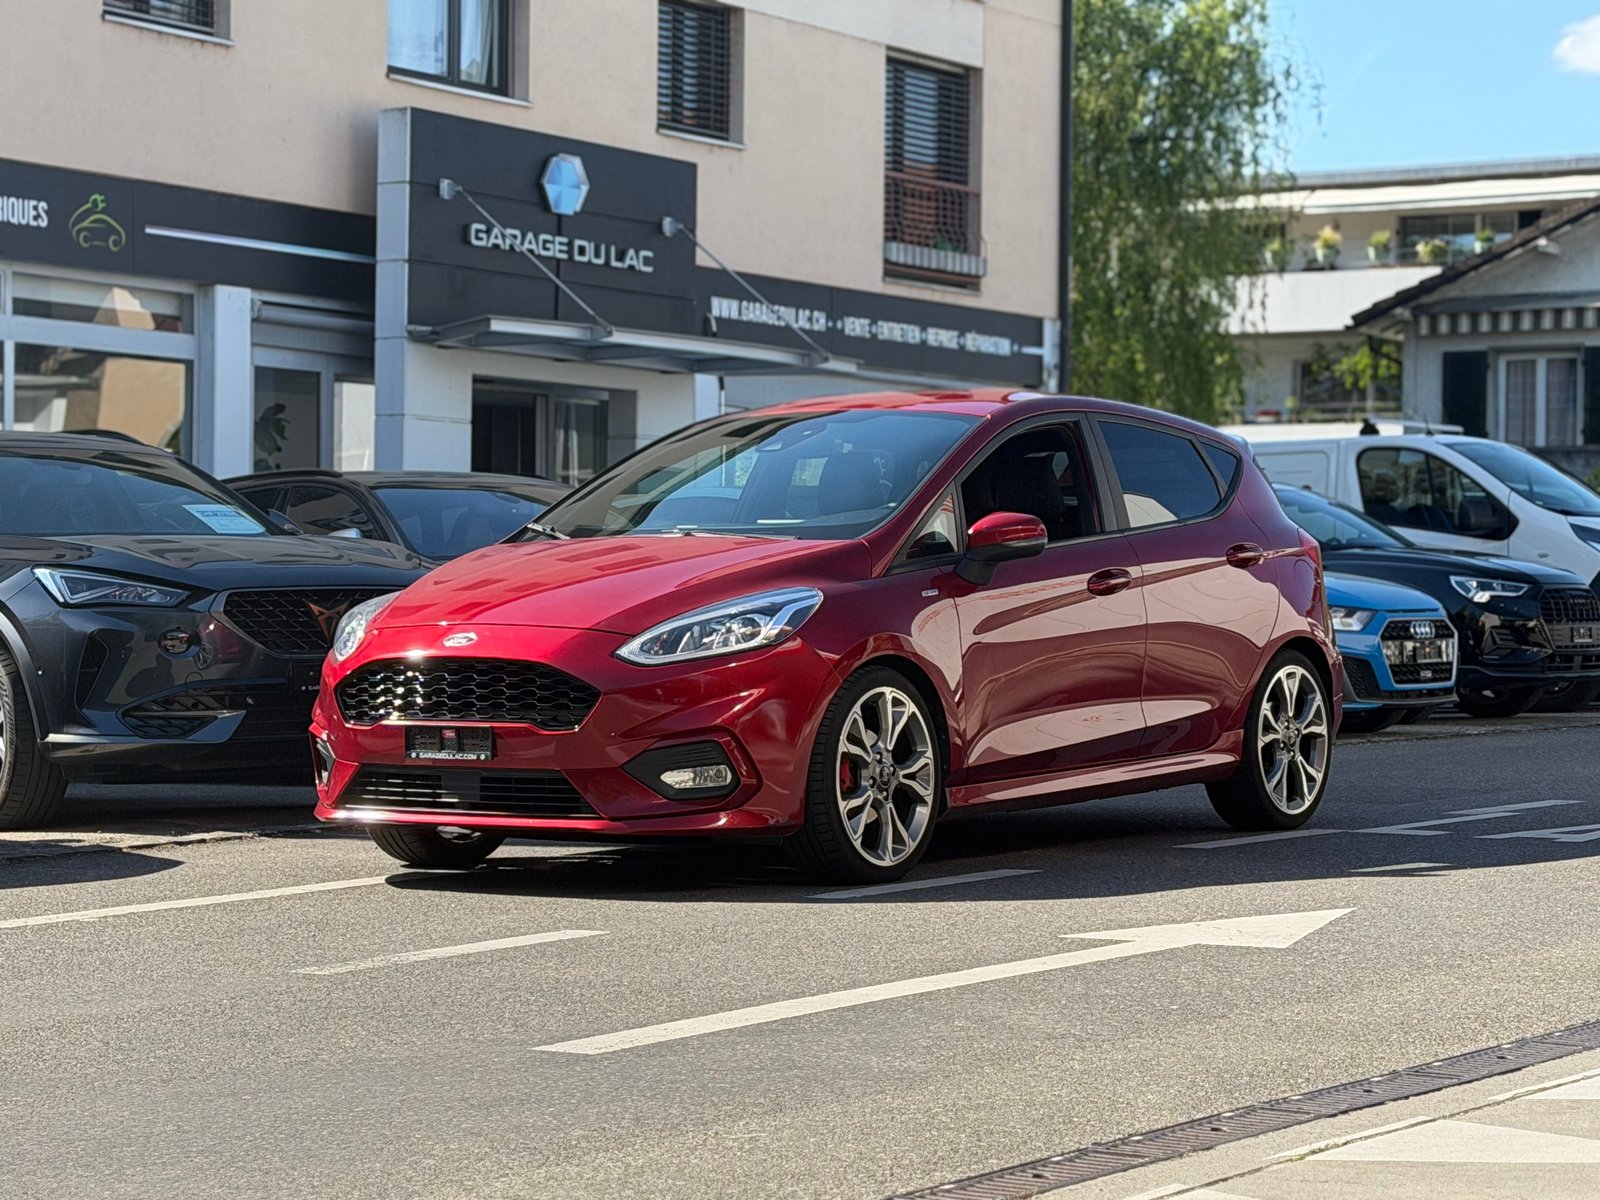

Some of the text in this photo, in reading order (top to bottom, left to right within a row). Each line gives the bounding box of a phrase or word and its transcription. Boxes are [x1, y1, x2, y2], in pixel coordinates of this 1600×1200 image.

[470, 222, 654, 273] GARAGE DU LAC
